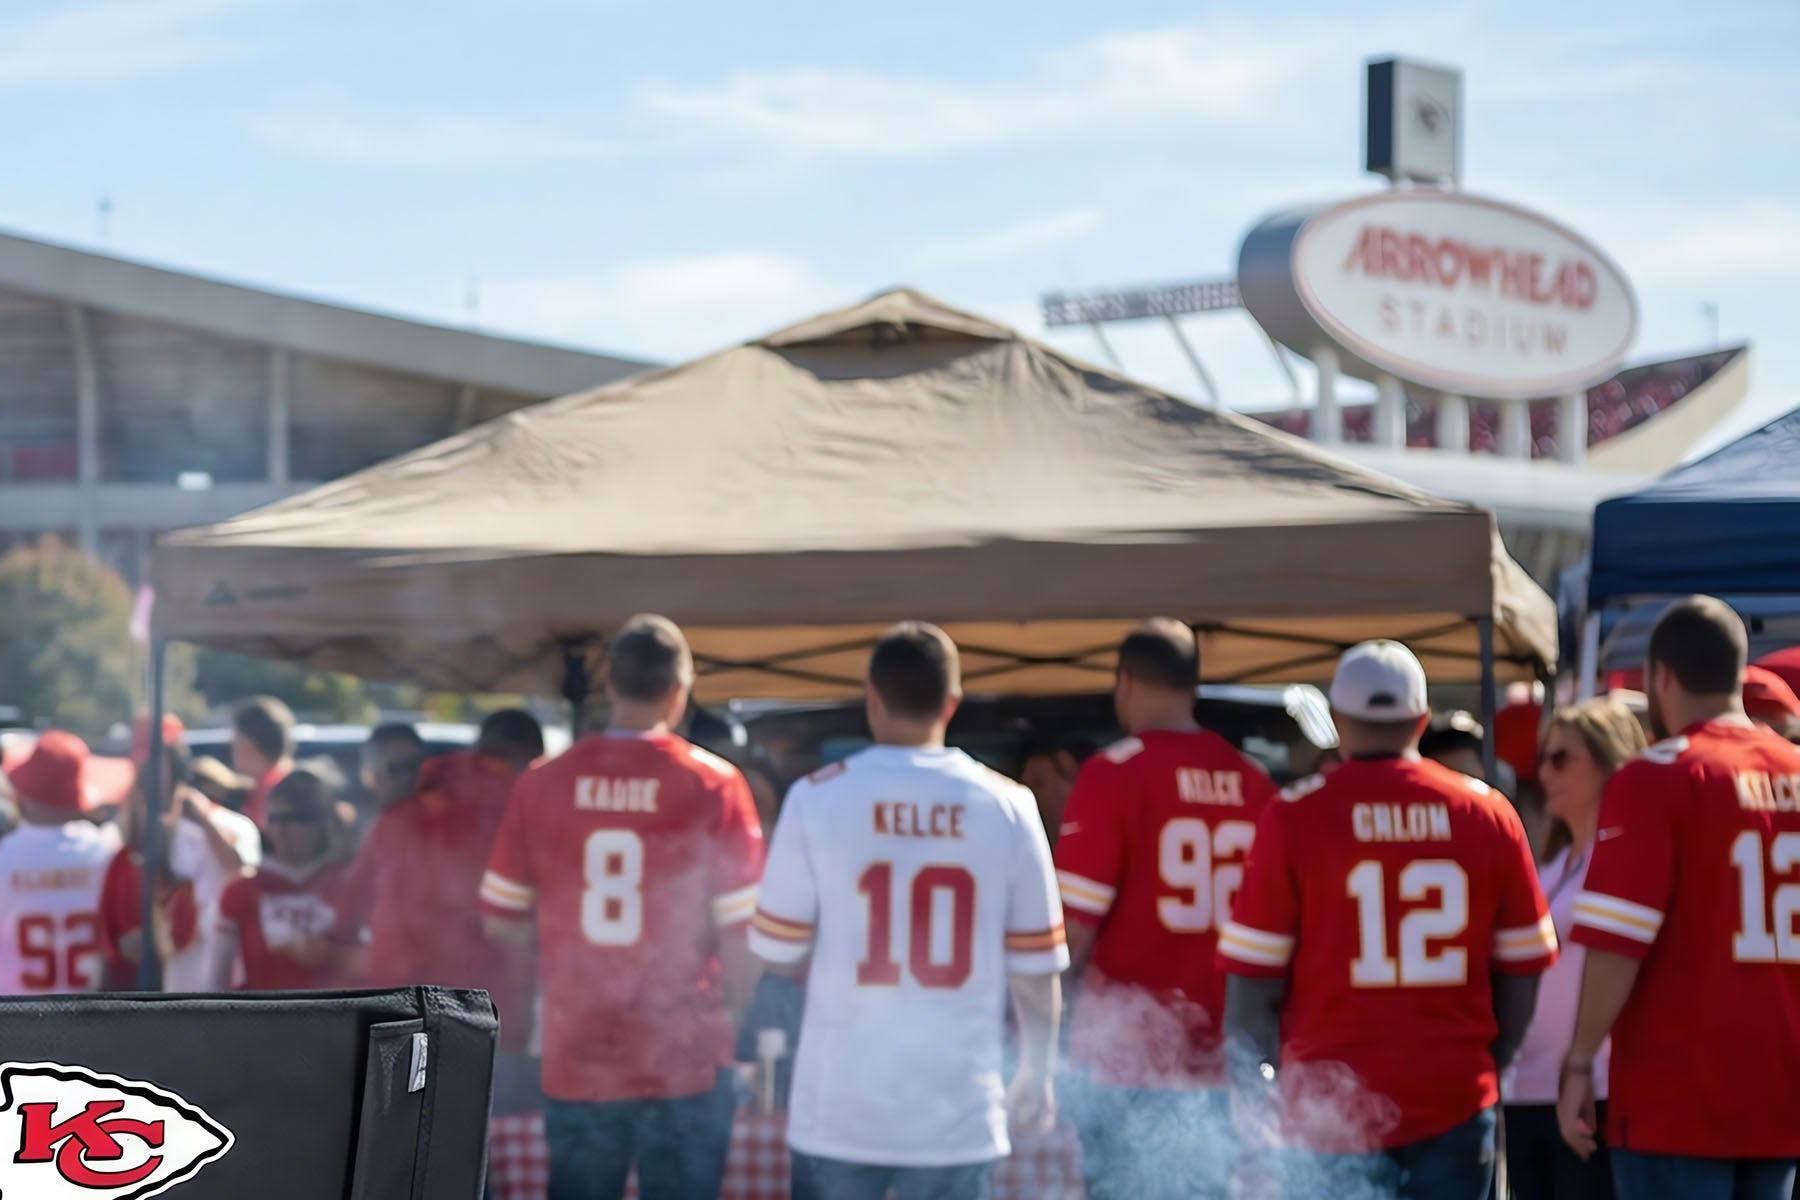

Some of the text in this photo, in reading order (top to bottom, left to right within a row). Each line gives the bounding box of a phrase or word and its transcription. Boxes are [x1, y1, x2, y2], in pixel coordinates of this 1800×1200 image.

[1342, 225, 1598, 310] ARROWHEAD
[1380, 293, 1567, 356] STADIUM
[872, 801, 965, 839] KELCE
[581, 827, 644, 947] 8
[856, 860, 978, 990] 10
[1346, 859, 1469, 988] 12
[13, 1100, 165, 1189] KC
